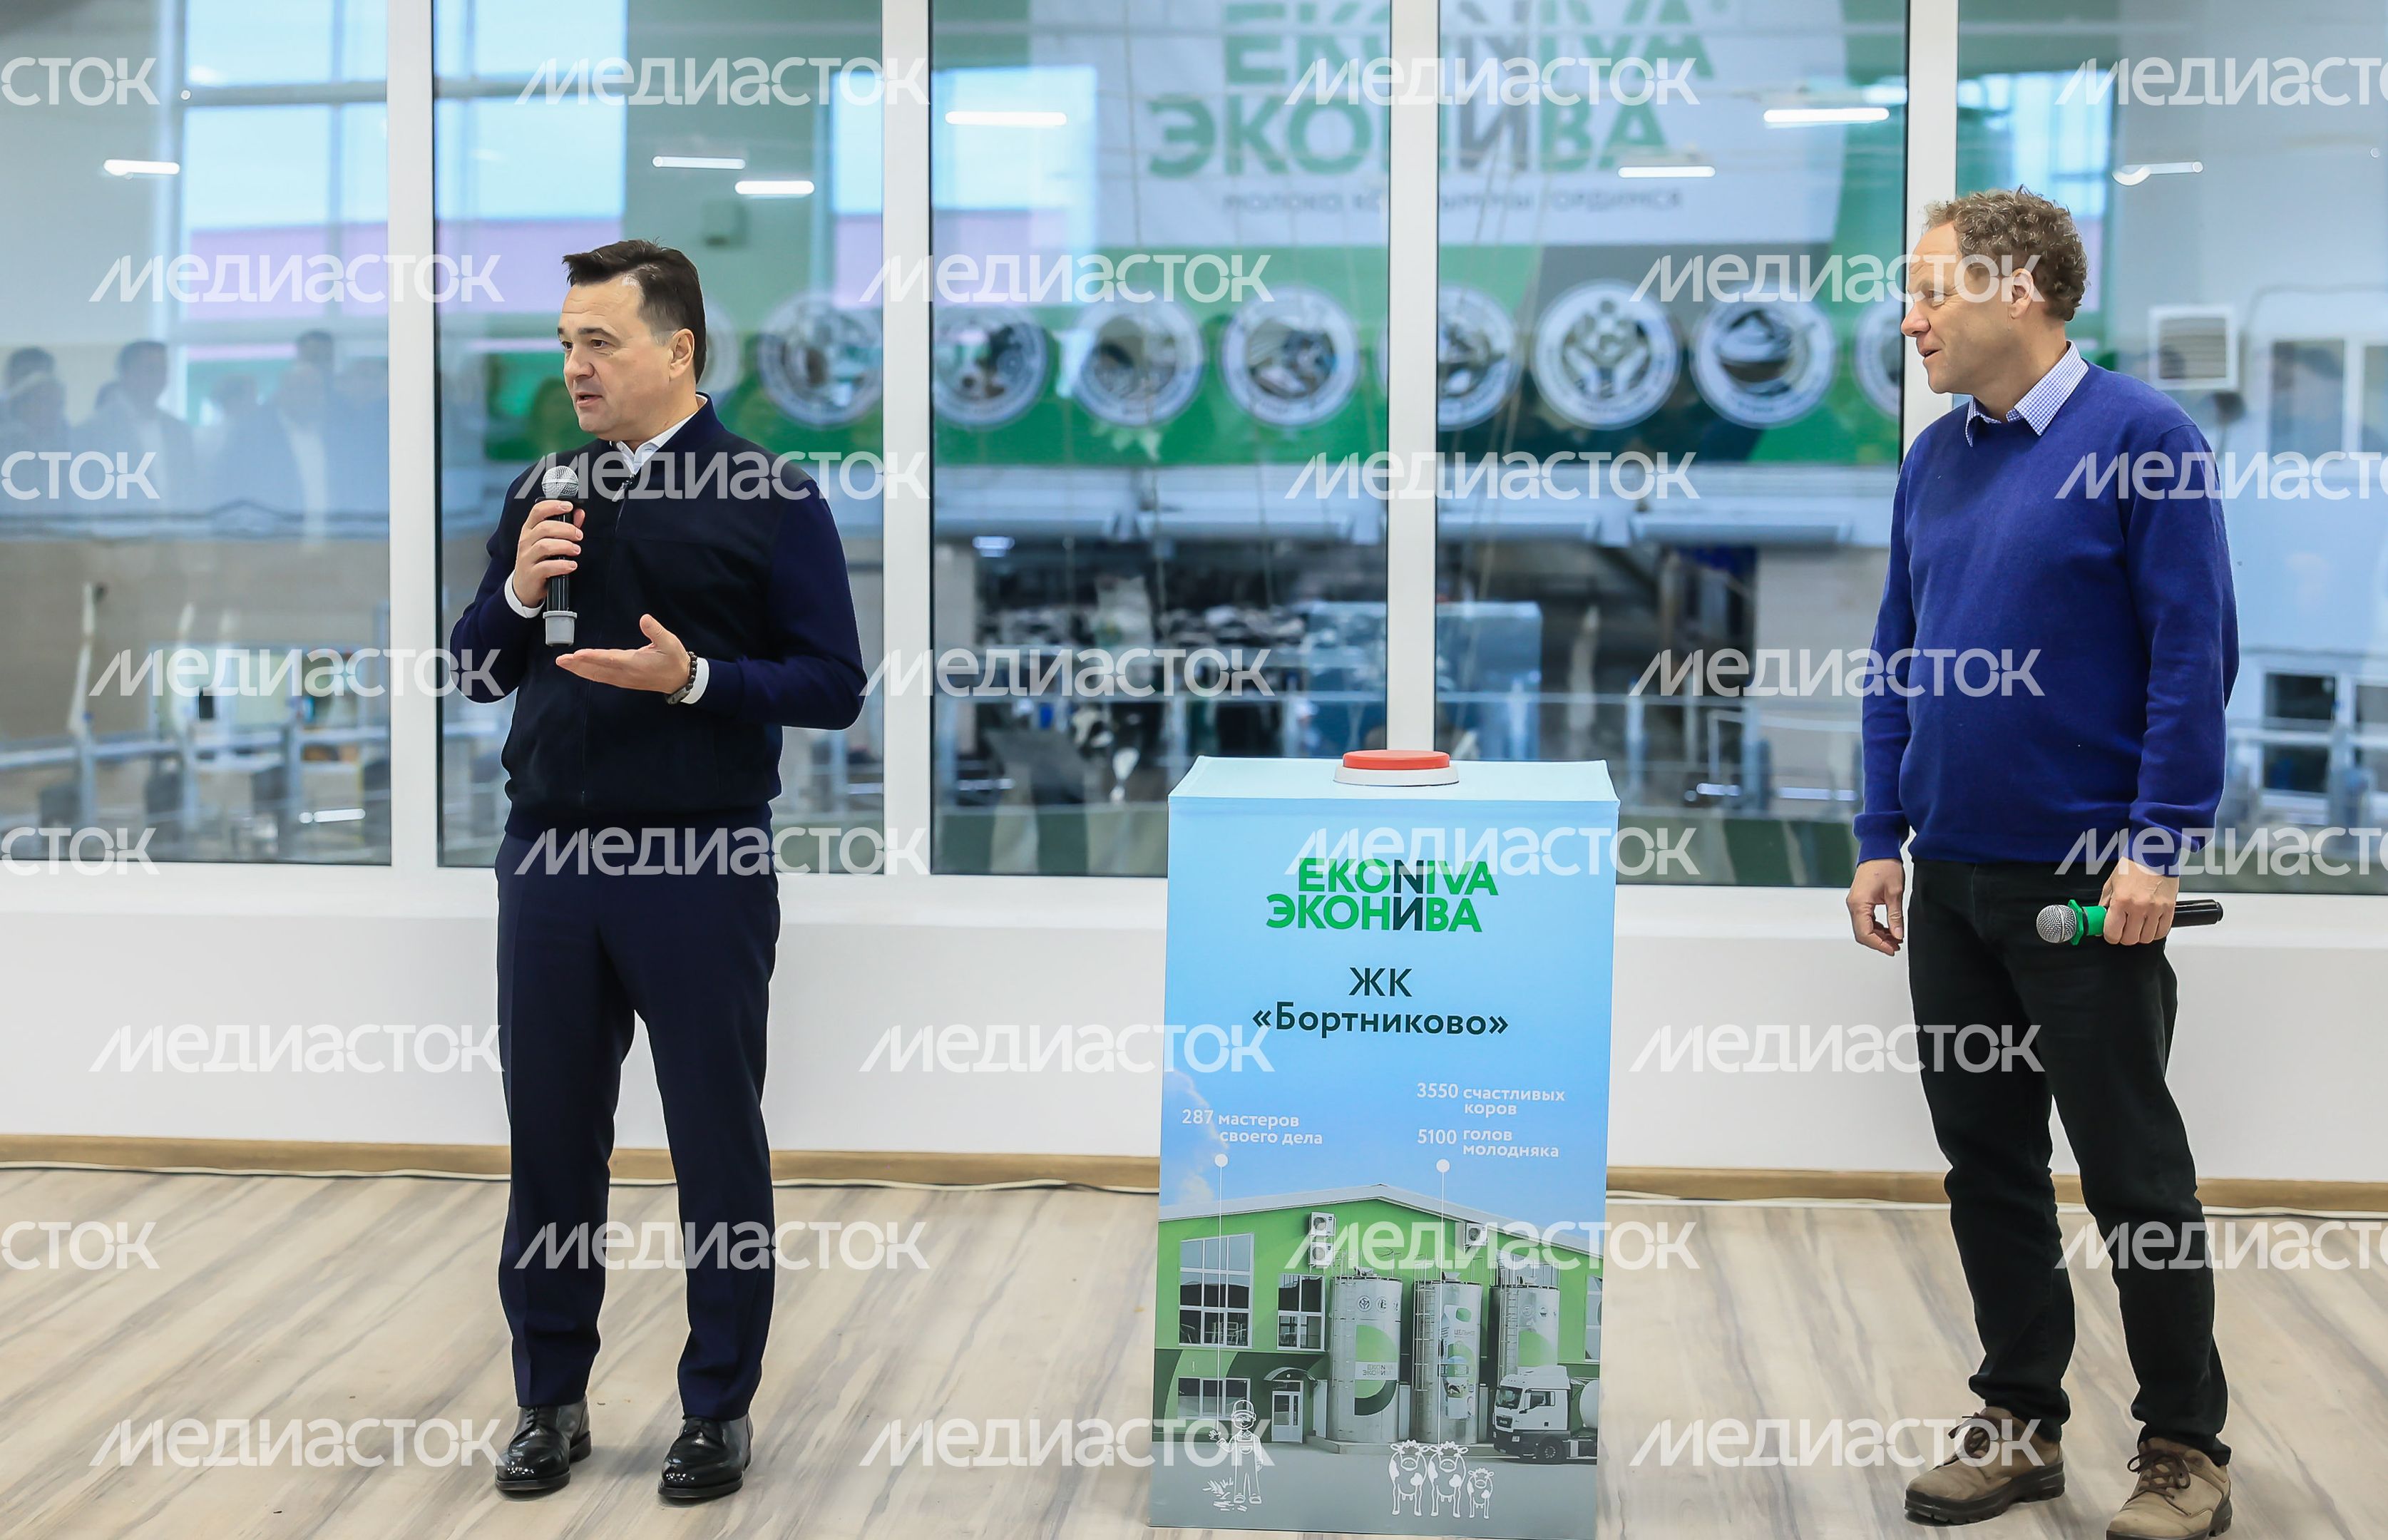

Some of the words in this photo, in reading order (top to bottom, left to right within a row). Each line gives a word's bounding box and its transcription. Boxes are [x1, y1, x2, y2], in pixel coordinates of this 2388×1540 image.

[1147, 93, 1670, 178] ЭКОИВА
[1298, 858, 1499, 896] EKONIVA
[1266, 894, 1482, 933] ЭКОНИВА
[1348, 967, 1413, 997] ЖК
[1253, 1002, 1509, 1039] «Бортниково»
[1417, 1083, 1458, 1099] 3550
[1463, 1087, 1565, 1102] счастливых
[1182, 1109, 1214, 1125] 287
[1218, 1114, 1299, 1130] мастеров
[1464, 1102, 1517, 1118] коров
[1219, 1131, 1278, 1144] своего
[1282, 1132, 1323, 1146] дела
[1417, 1129, 1457, 1146] 5100
[1462, 1127, 1512, 1142] голов
[1462, 1144, 1559, 1159] молодняка
